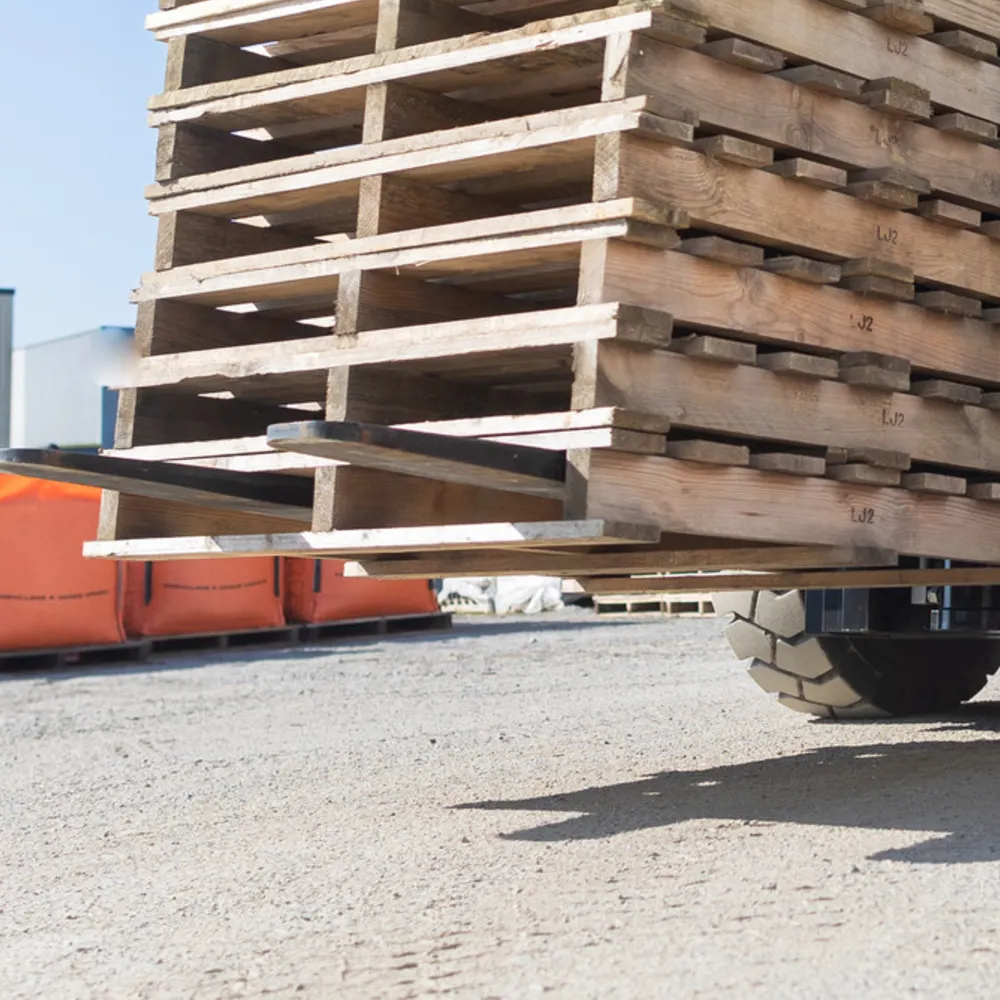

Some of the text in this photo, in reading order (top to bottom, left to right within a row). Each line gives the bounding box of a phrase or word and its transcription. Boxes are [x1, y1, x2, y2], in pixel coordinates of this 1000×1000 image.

[887, 37, 908, 56] LJ2
[877, 225, 899, 245] LJ2
[882, 408, 905, 428] LJ2
[851, 507, 875, 524] LJ2
